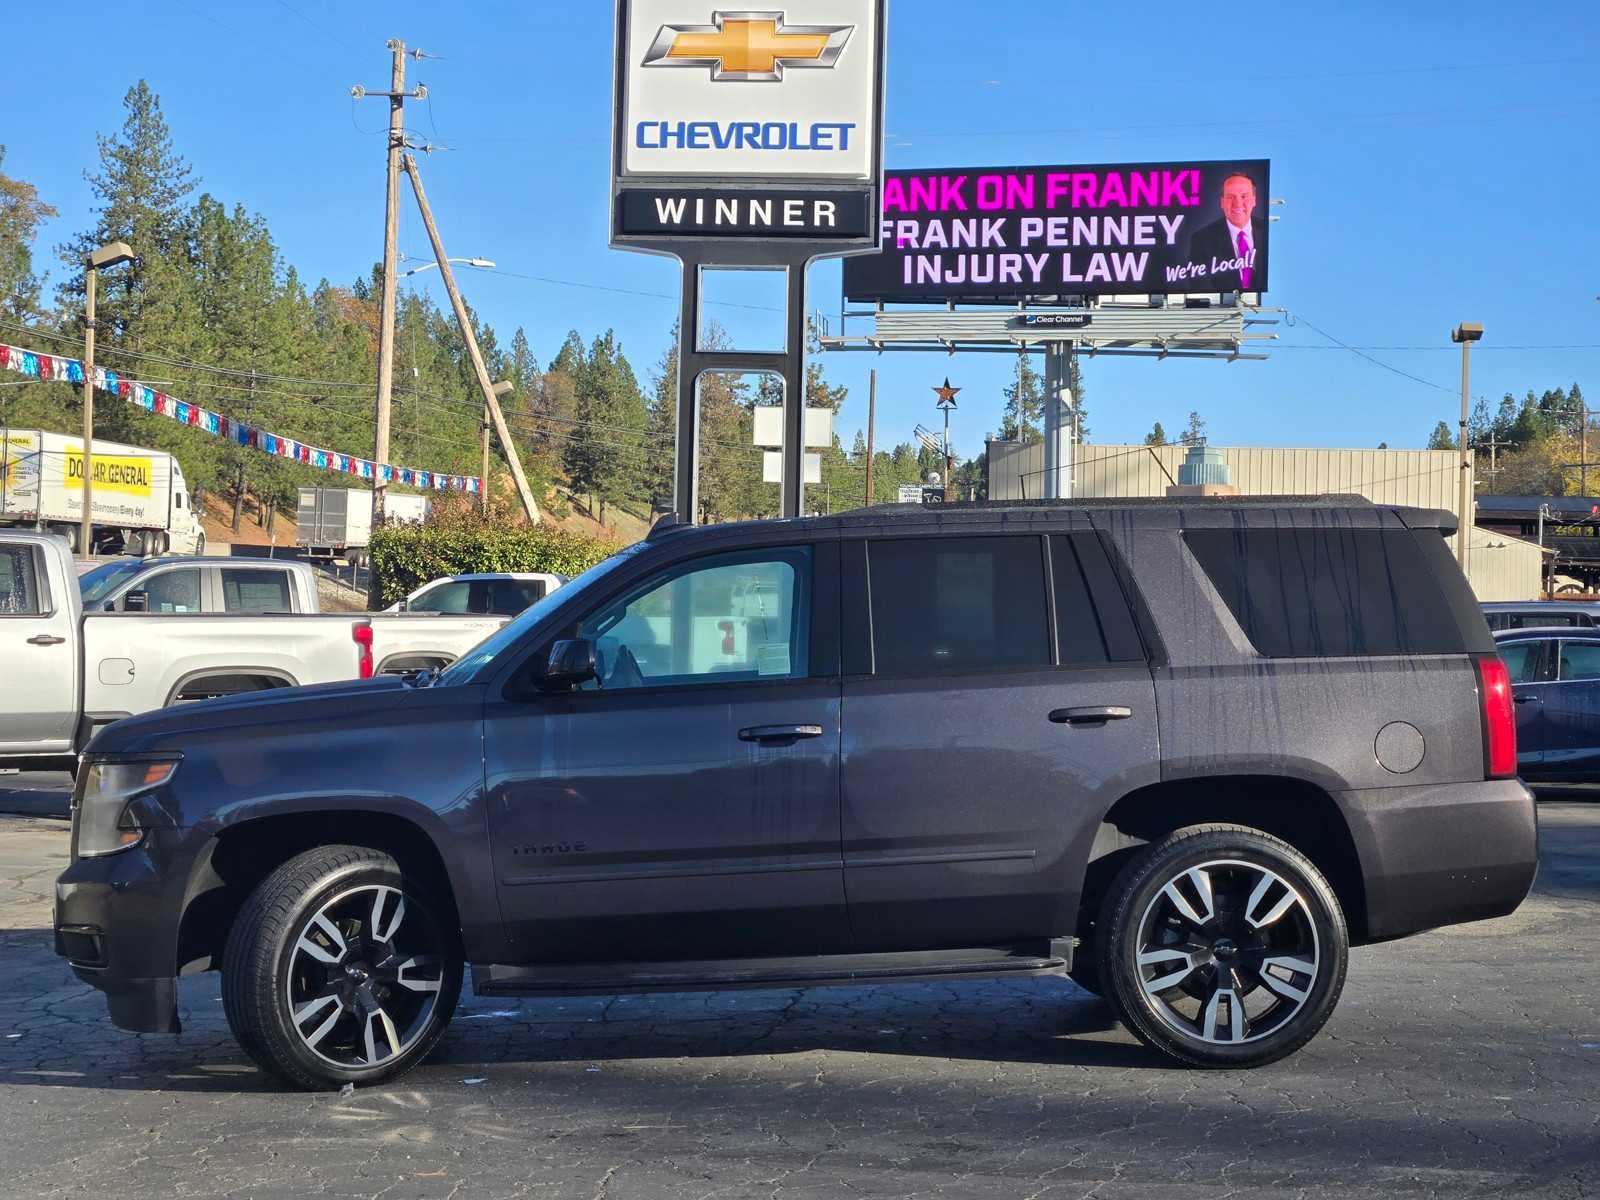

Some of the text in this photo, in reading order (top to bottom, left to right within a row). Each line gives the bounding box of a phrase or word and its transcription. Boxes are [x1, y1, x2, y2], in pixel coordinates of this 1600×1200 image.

[636, 121, 856, 150] CHEVROLET
[883, 170, 1201, 212] ANK ON FRANK!
[655, 198, 836, 226] WINNER
[1020, 214, 1185, 247] PENNEY
[904, 252, 1149, 284] INJURY LAW
[1166, 248, 1257, 282] We're Local!
[1036, 315, 1083, 323] Clear Channel
[69, 457, 148, 486] DOAR GENERAL
